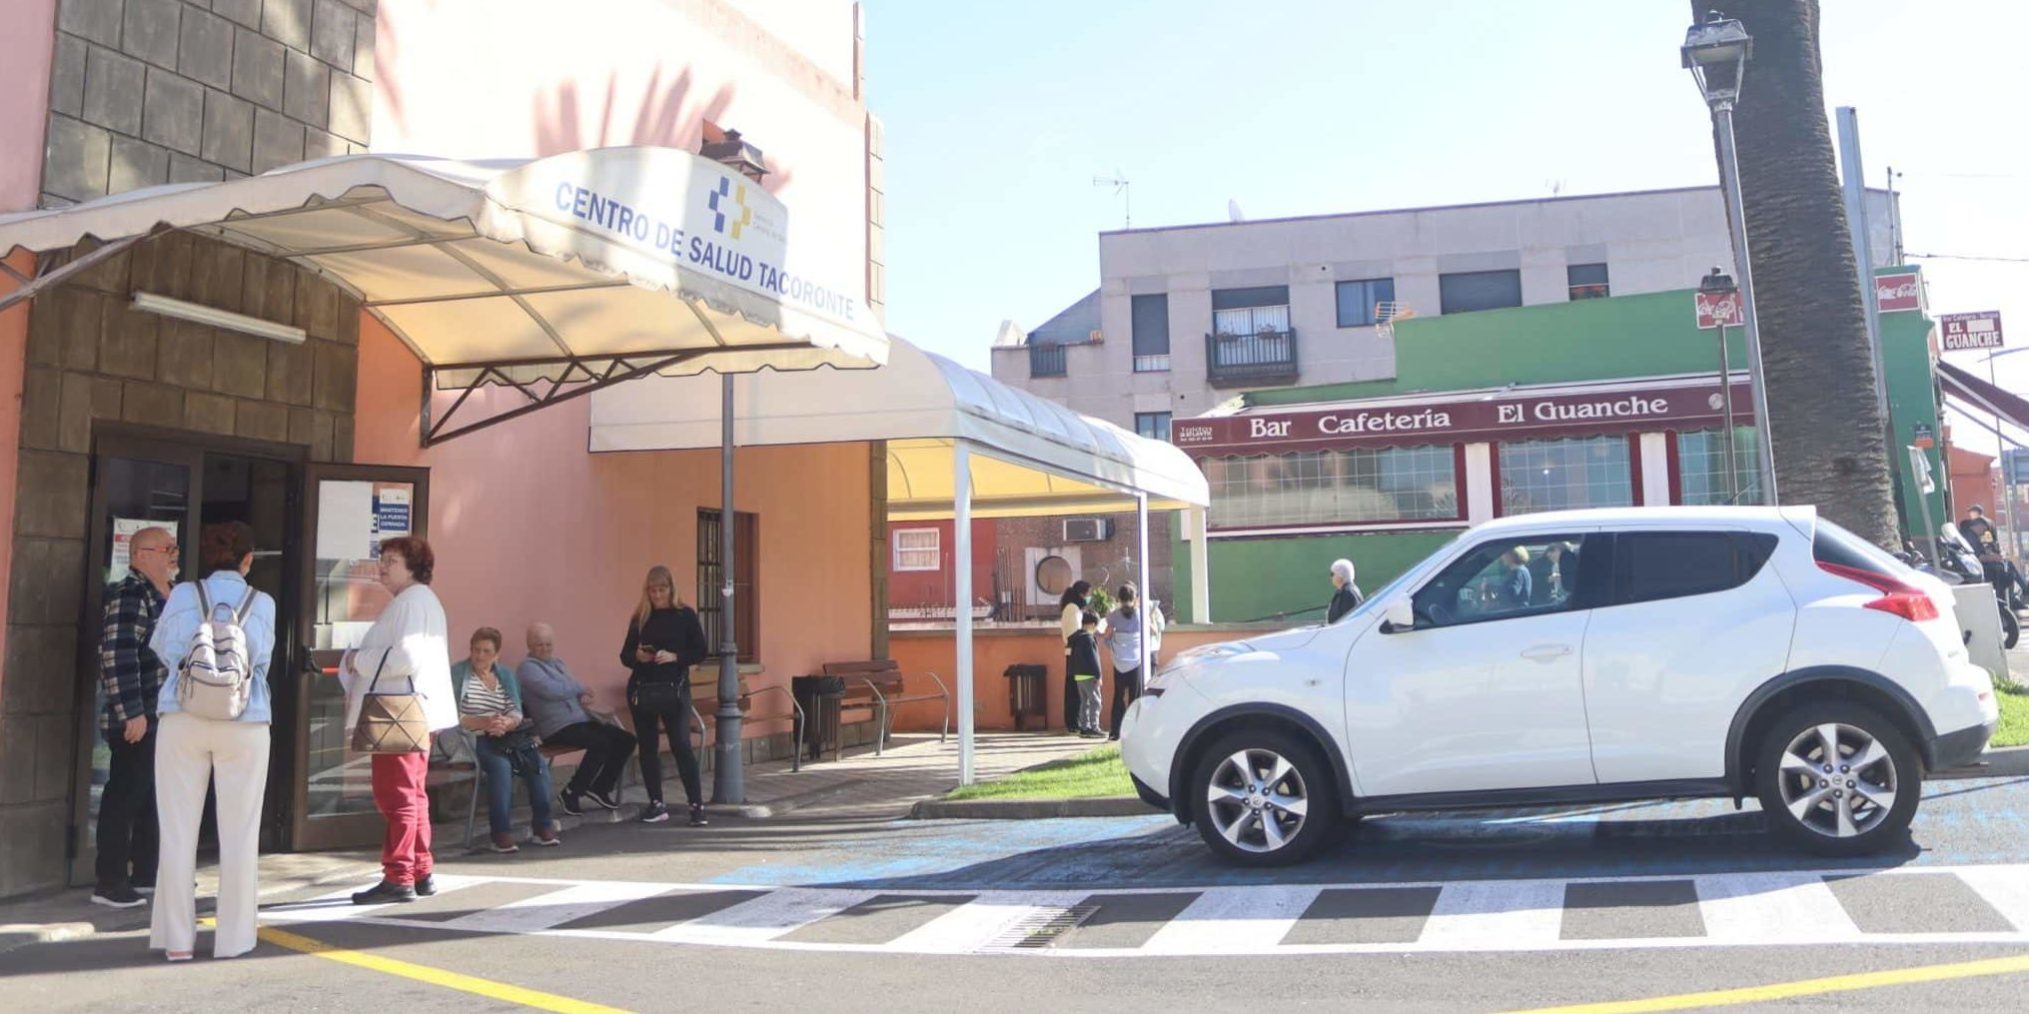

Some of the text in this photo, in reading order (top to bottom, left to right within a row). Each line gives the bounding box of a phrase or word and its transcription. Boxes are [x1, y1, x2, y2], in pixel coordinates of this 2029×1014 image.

[556, 181, 855, 321] CENTRO DE SALUD TACORONTE
[1946, 331, 2000, 349] GUANCHE
[1949, 322, 1964, 333] EL
[1250, 396, 1669, 438] Bar Cafetería El Guanche
